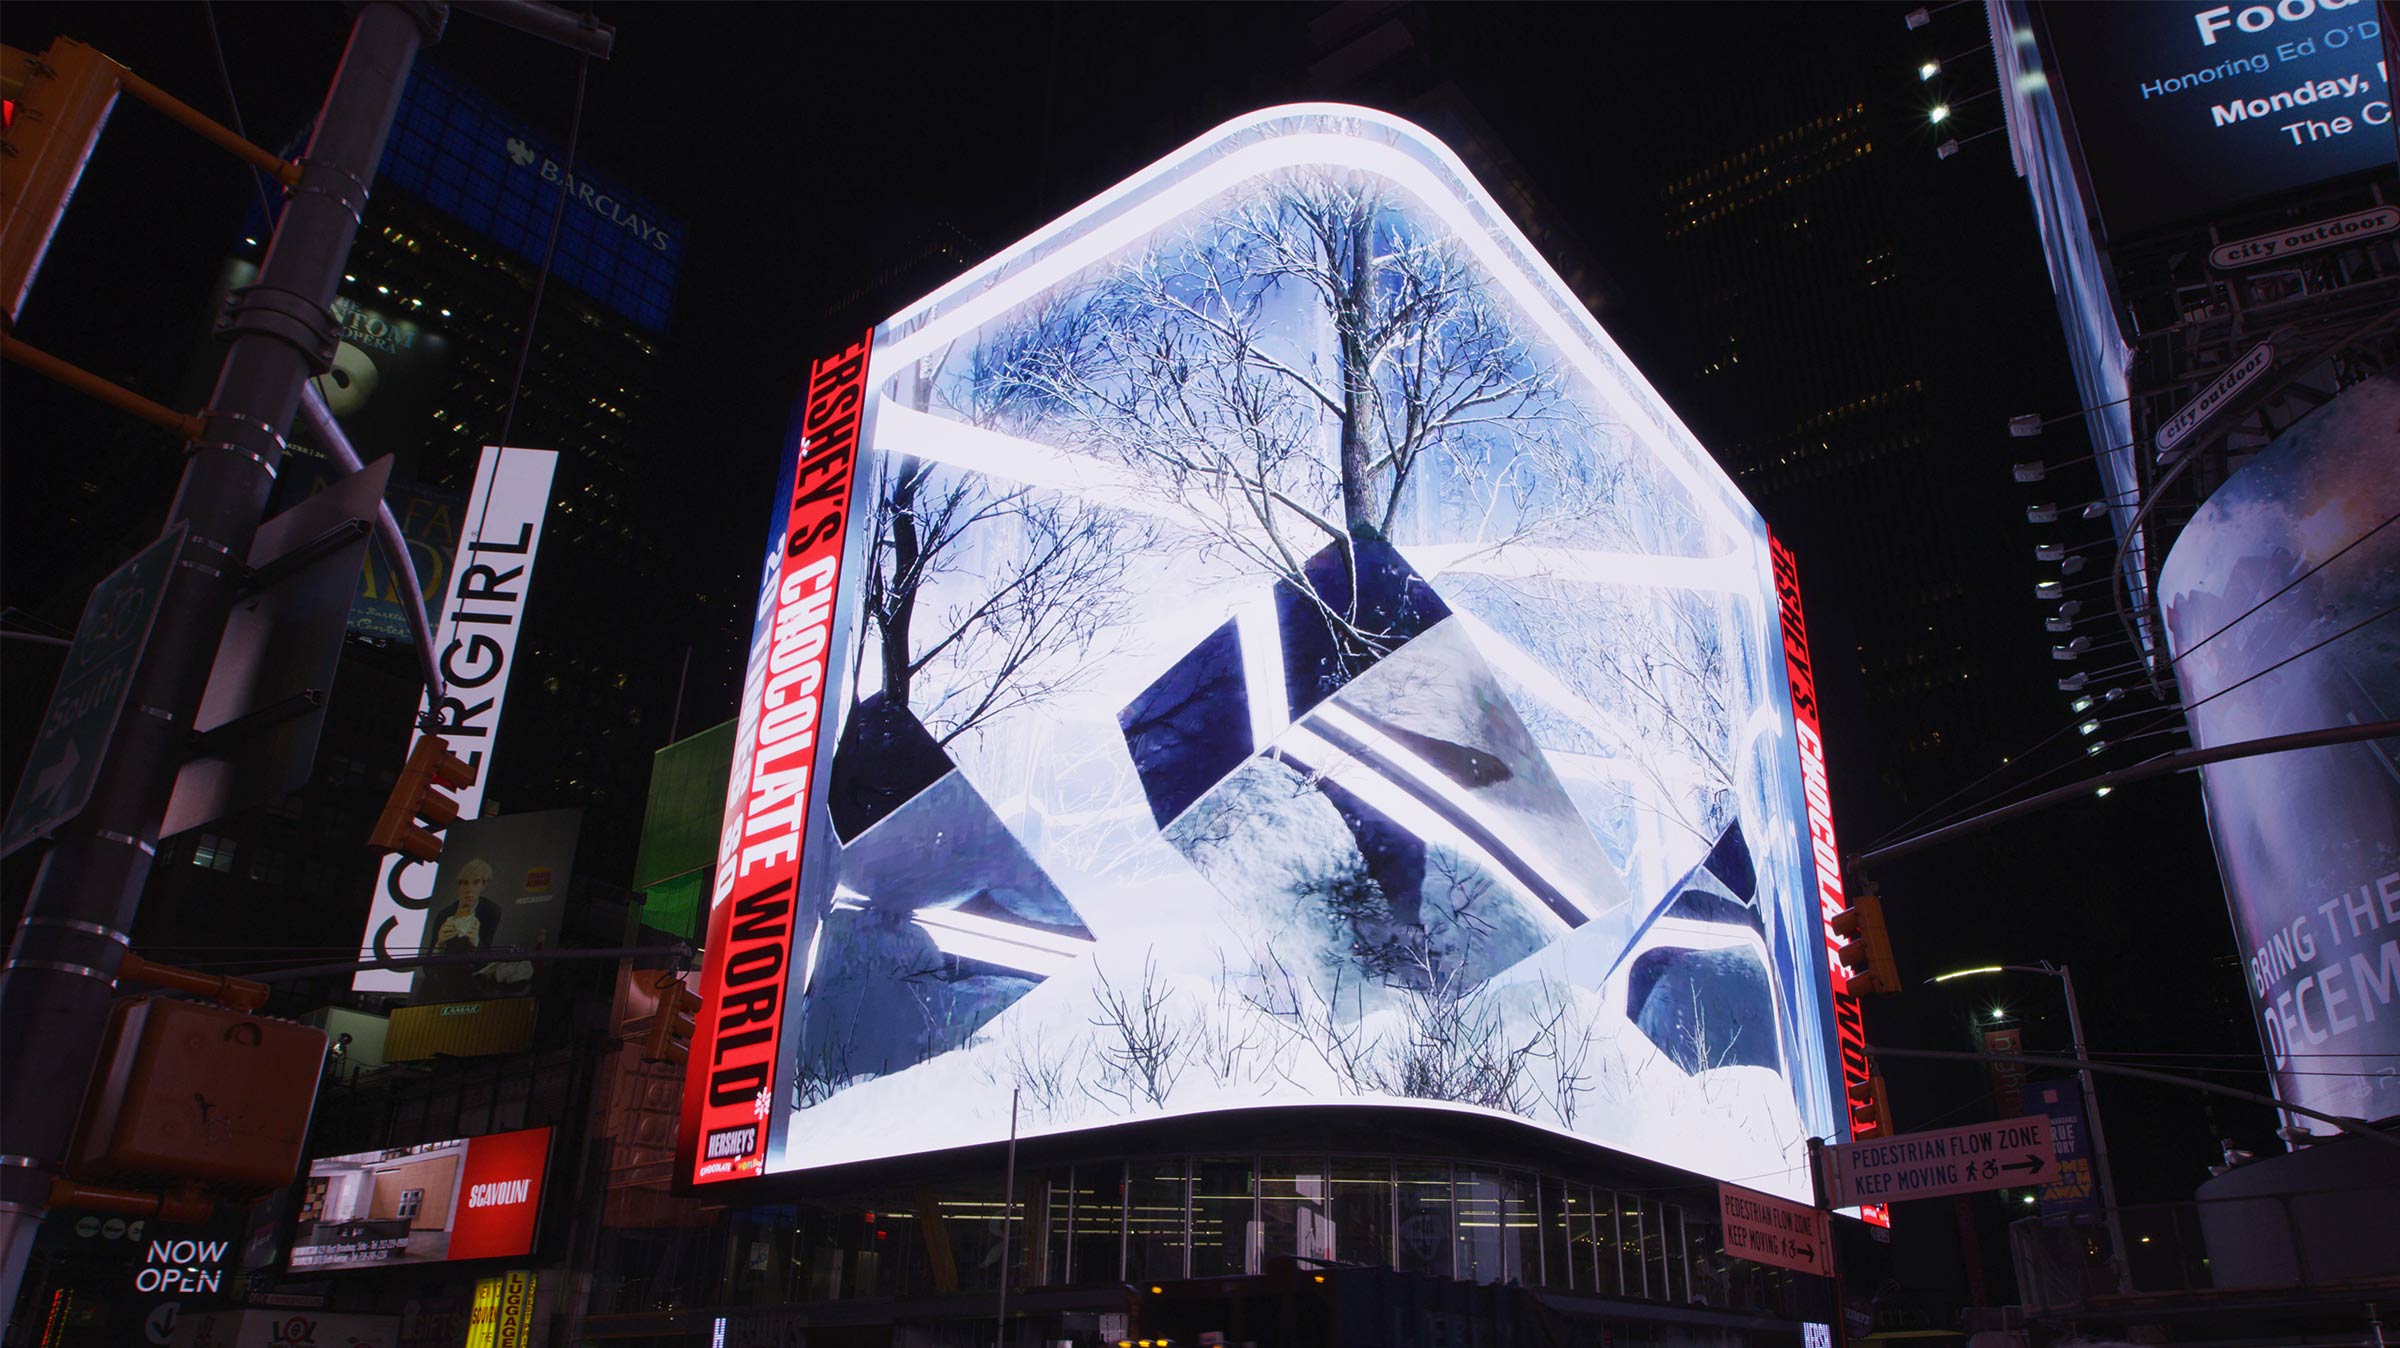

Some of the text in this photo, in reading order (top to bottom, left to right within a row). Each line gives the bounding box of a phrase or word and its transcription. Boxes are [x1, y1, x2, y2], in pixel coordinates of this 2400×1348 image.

[2195, 0, 2362, 46] Foo
[2140, 52, 2270, 100] Honoring
[2276, 37, 2317, 62] Ed
[2210, 73, 2370, 127] Monday,
[2280, 115, 2353, 146] The
[540, 158, 670, 251] BARCLAYS
[2227, 213, 2388, 261] city outdoor
[2166, 351, 2265, 440] city outdoor
[729, 614, 775, 810] TIMES
[740, 554, 838, 878] CHOCOLATE
[712, 812, 744, 911] SQ
[2251, 871, 2400, 999] BRING THE
[442, 1004, 479, 1015] LAMAR
[708, 876, 793, 1109] WORLD
[707, 1127, 756, 1159] HERSHEY'S
[1852, 1125, 2042, 1169] PEDESTRIAN FLOW ZONE
[2050, 1124, 2075, 1142] RUE
[700, 1161, 732, 1177] CHOCOLATE
[1855, 1164, 1958, 1196] KEEP MOVING
[468, 1178, 530, 1209] SCAVOLINI
[1725, 1195, 1813, 1237] PEDESTRIAN FLOW ZONE
[146, 1239, 229, 1264] NOW
[1727, 1223, 1779, 1256] KEEP MOVING
[135, 1267, 223, 1293] OPEN
[501, 1273, 523, 1348] LUGGAGE
